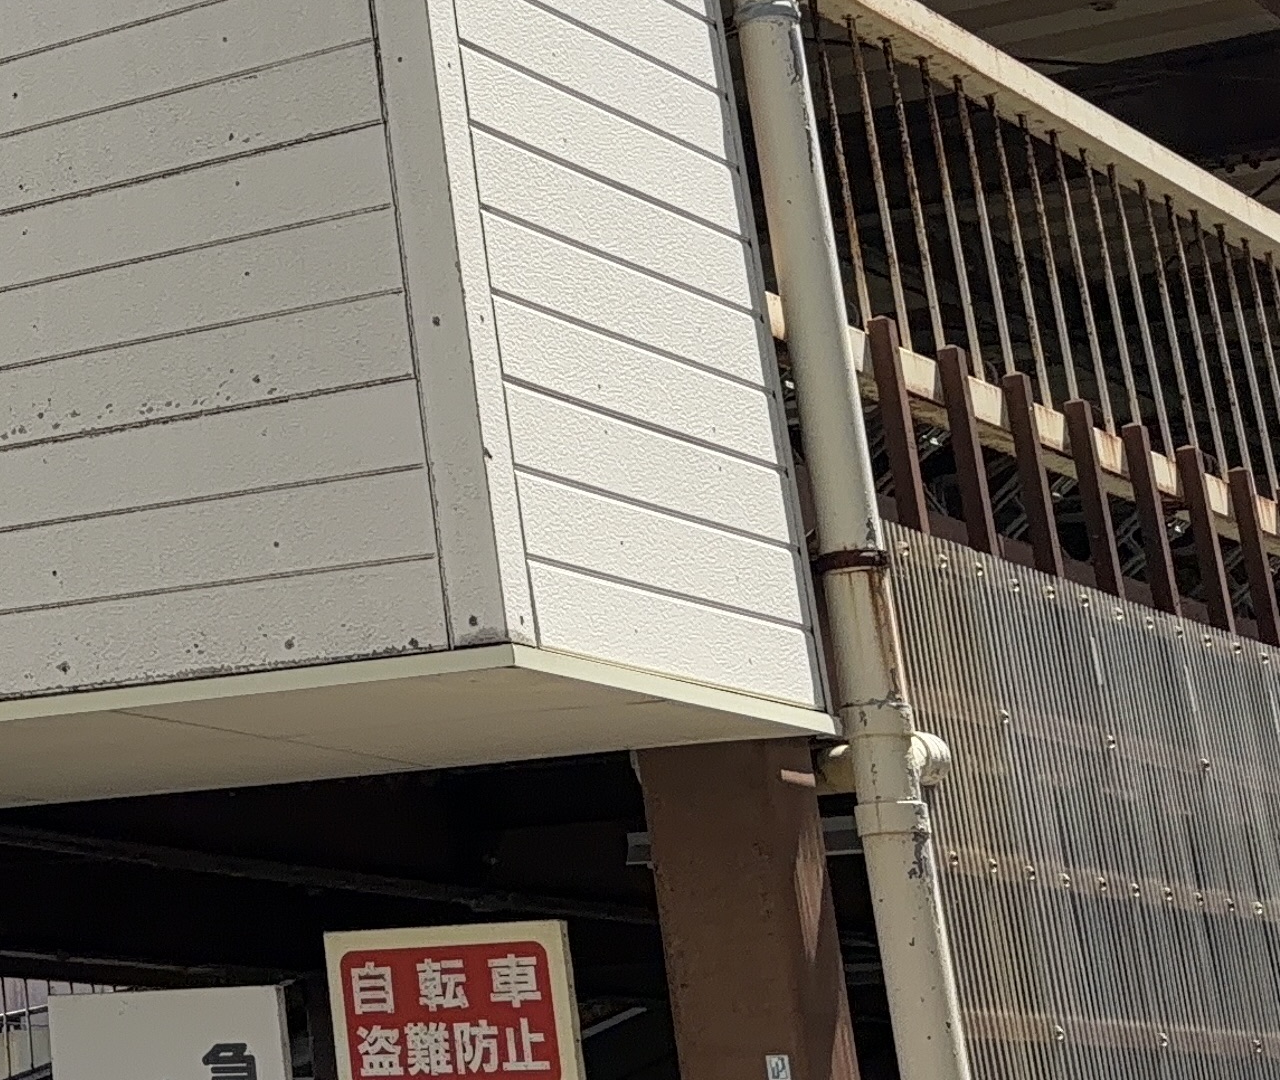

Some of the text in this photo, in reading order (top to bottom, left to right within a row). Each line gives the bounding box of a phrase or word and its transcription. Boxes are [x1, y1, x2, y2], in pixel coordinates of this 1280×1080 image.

[351, 953, 542, 1015] 自転車
[356, 1017, 551, 1077] 盗難防止
